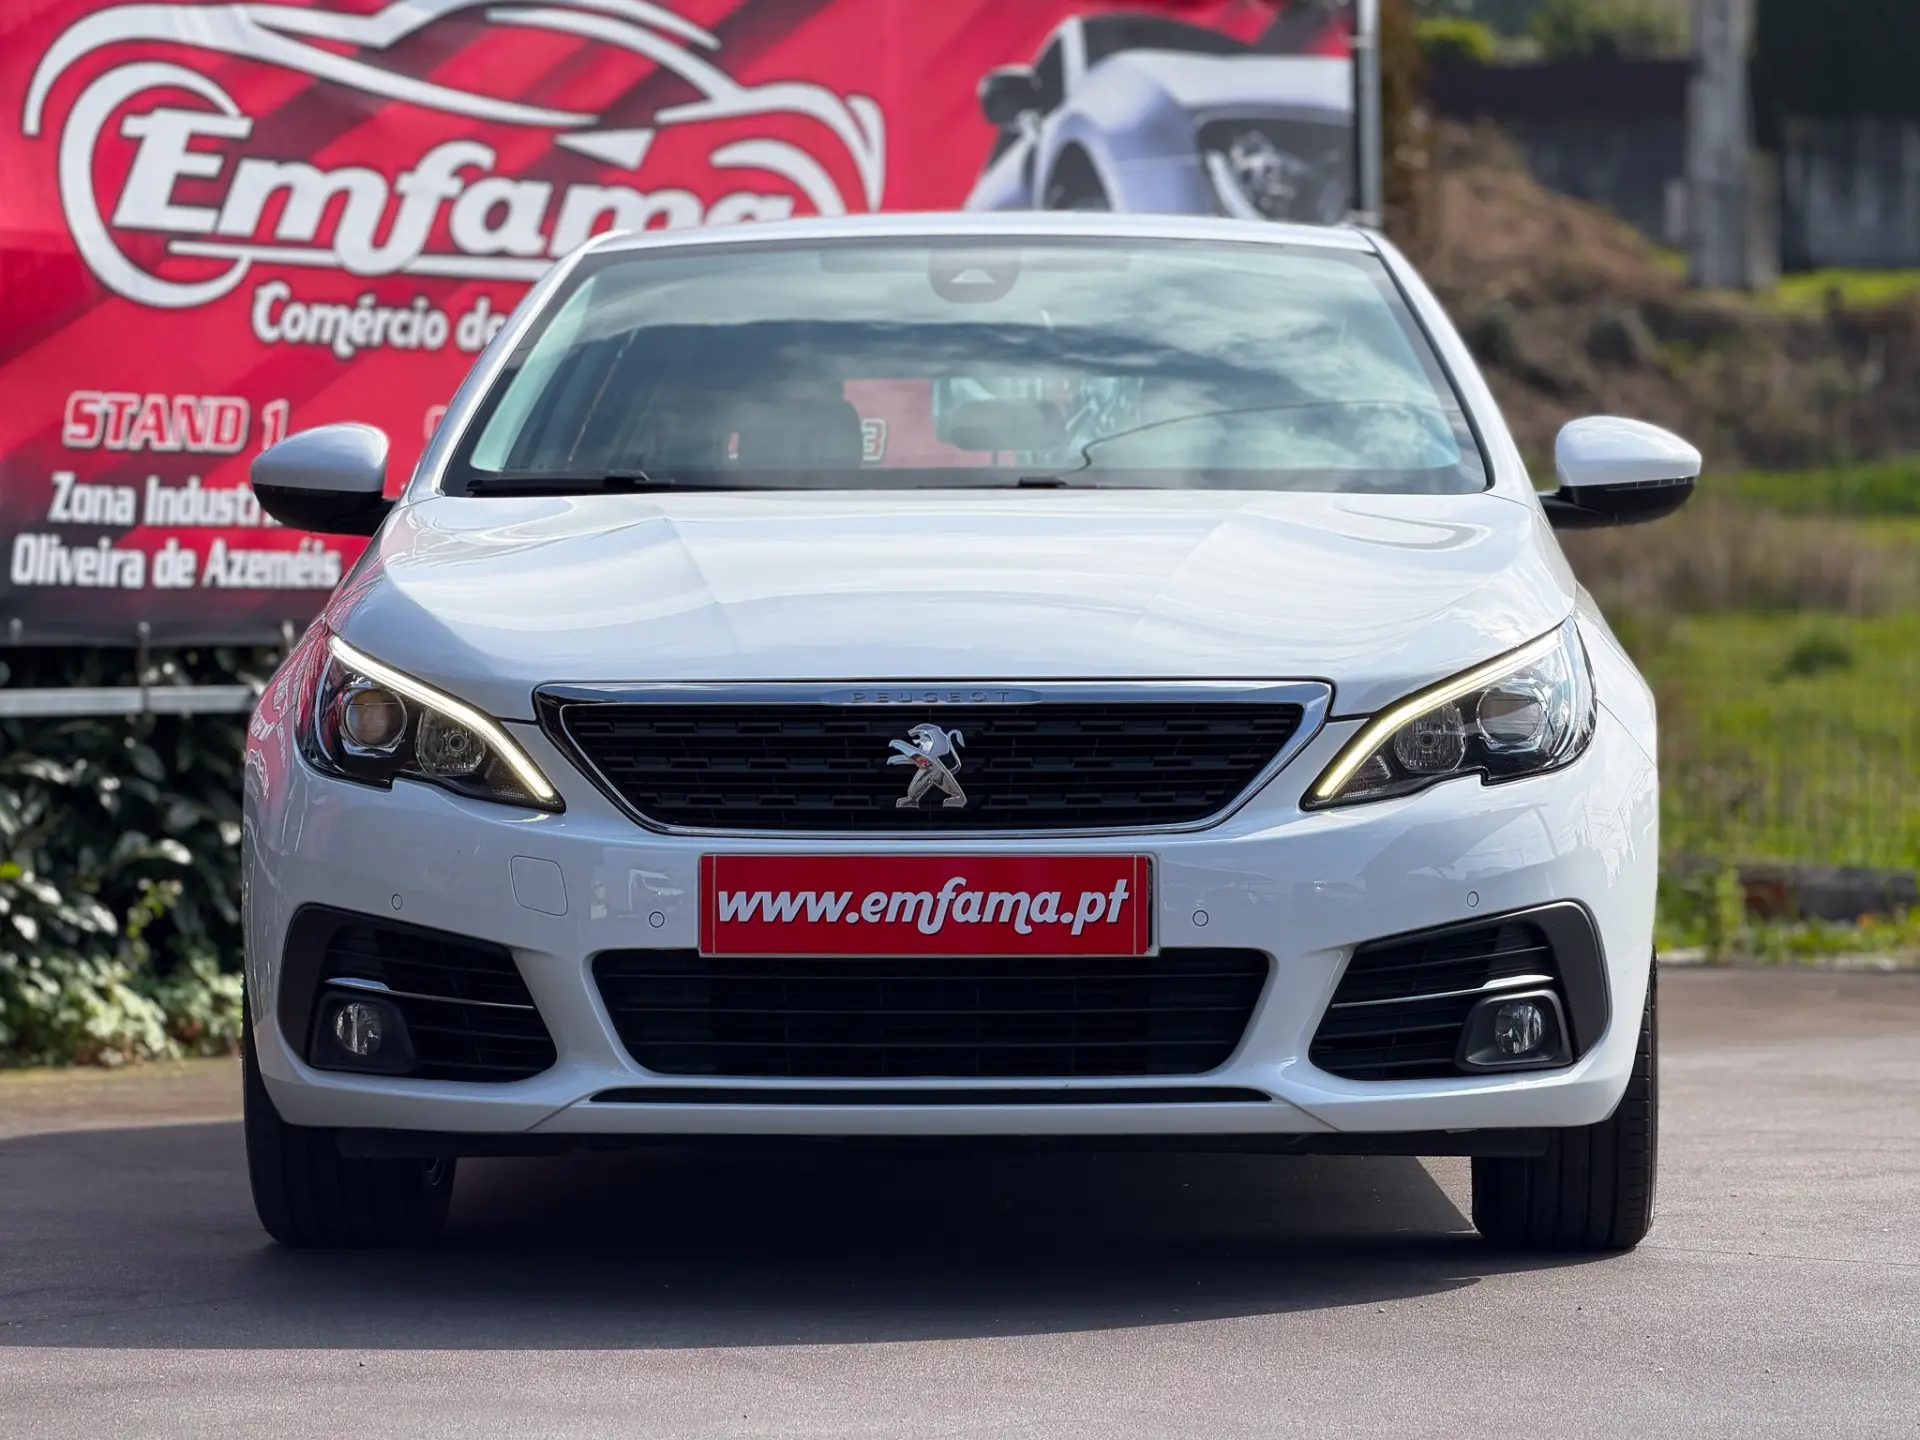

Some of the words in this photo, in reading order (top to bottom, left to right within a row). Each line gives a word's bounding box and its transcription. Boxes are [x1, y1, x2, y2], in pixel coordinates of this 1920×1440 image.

[252, 280, 449, 359] Comércio
[62, 390, 250, 454] STAND
[262, 398, 290, 450] 1
[47, 471, 137, 526] Zona
[10, 532, 147, 589] Oliveira
[152, 536, 197, 589] de
[201, 535, 342, 590] Azeméis
[852, 691, 1010, 704] PEUGEOT
[718, 876, 1129, 936] www.emfama.pt
